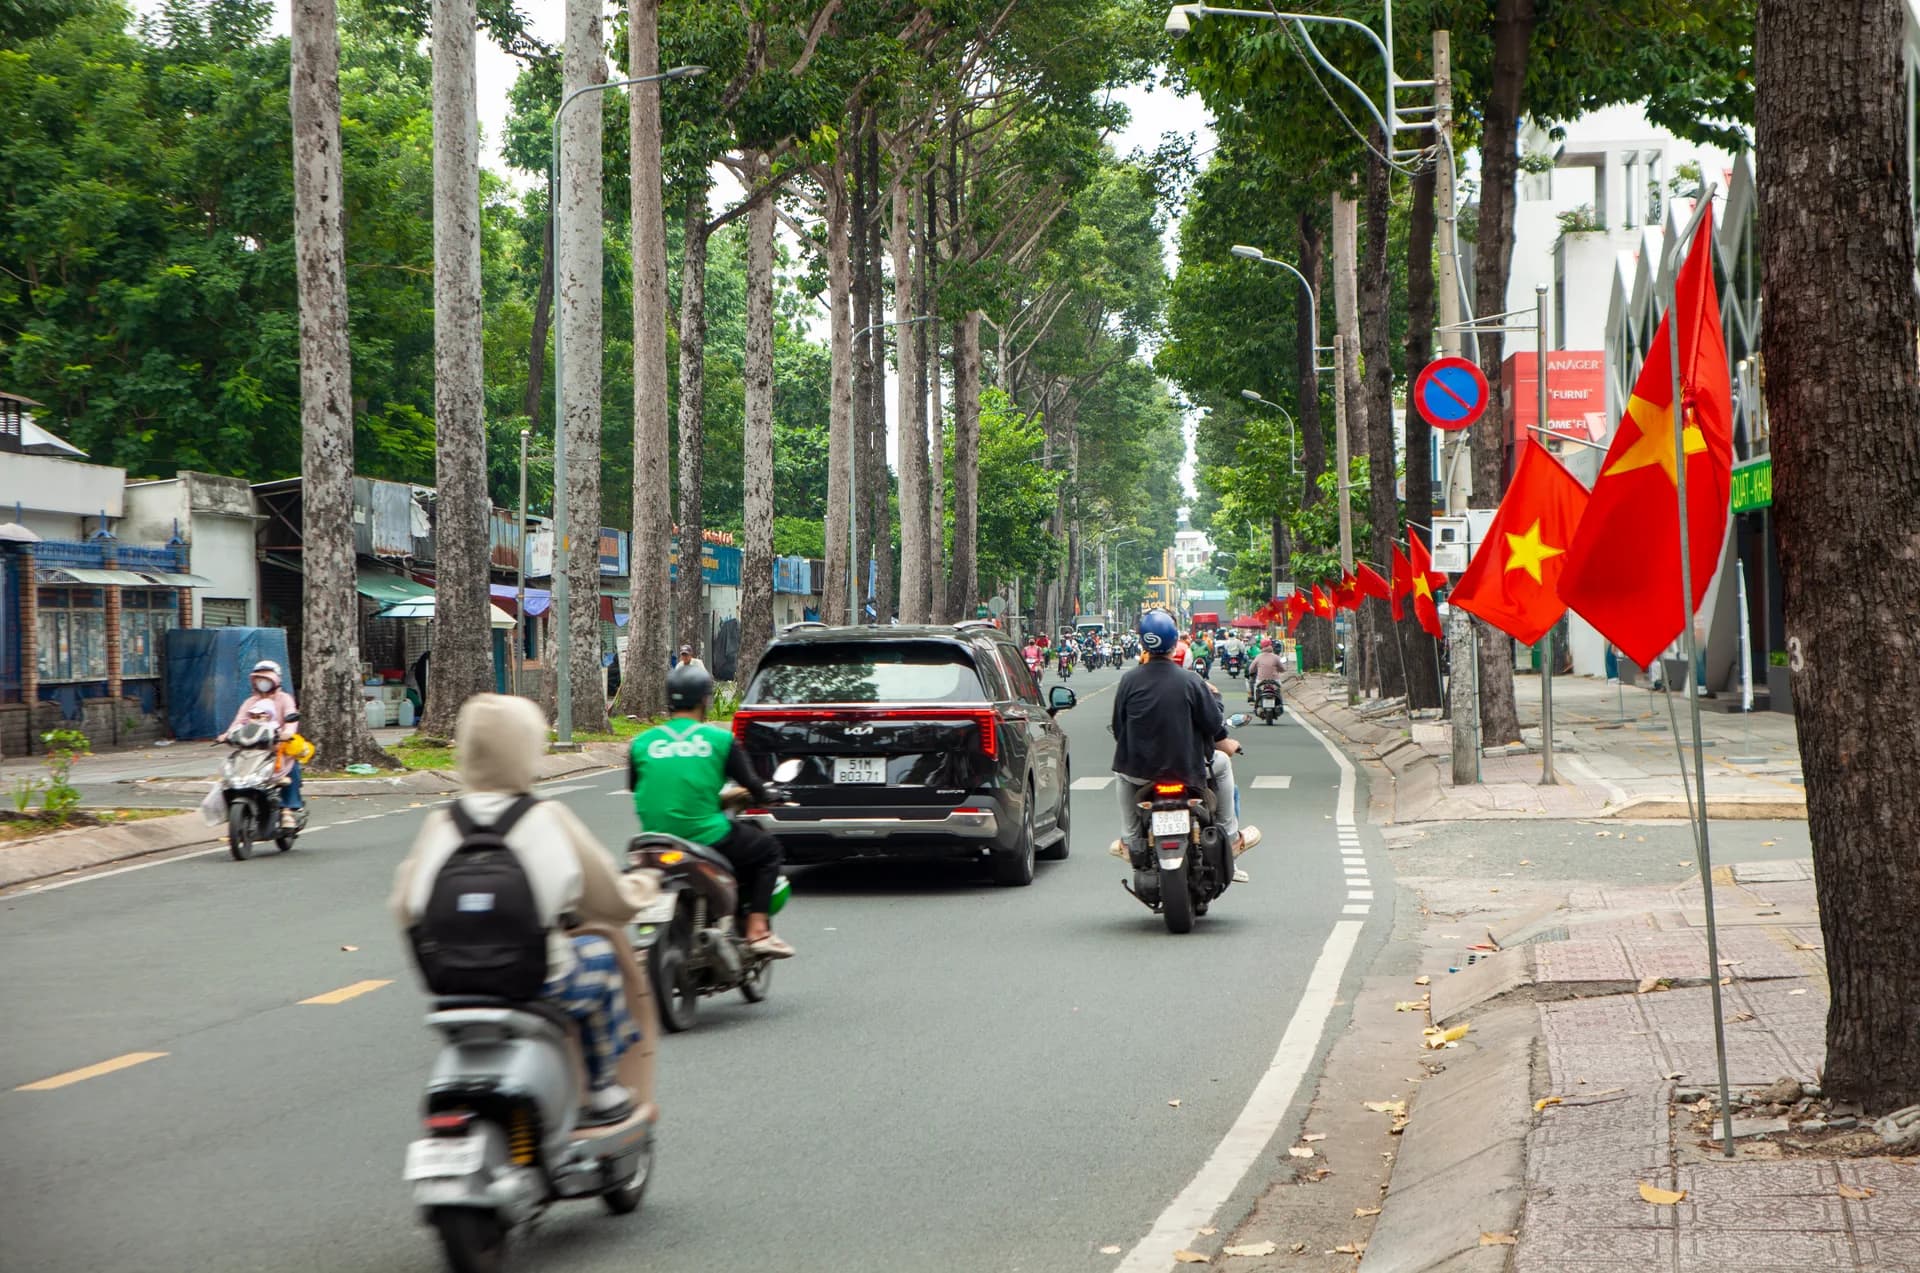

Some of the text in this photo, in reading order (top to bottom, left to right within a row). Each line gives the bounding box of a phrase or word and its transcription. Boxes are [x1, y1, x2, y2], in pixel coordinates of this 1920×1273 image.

[1548, 360, 1600, 370] ANAGER
[648, 734, 712, 759] Grab
[849, 759, 872, 770] 51M
[839, 771, 879, 782] 803.71
